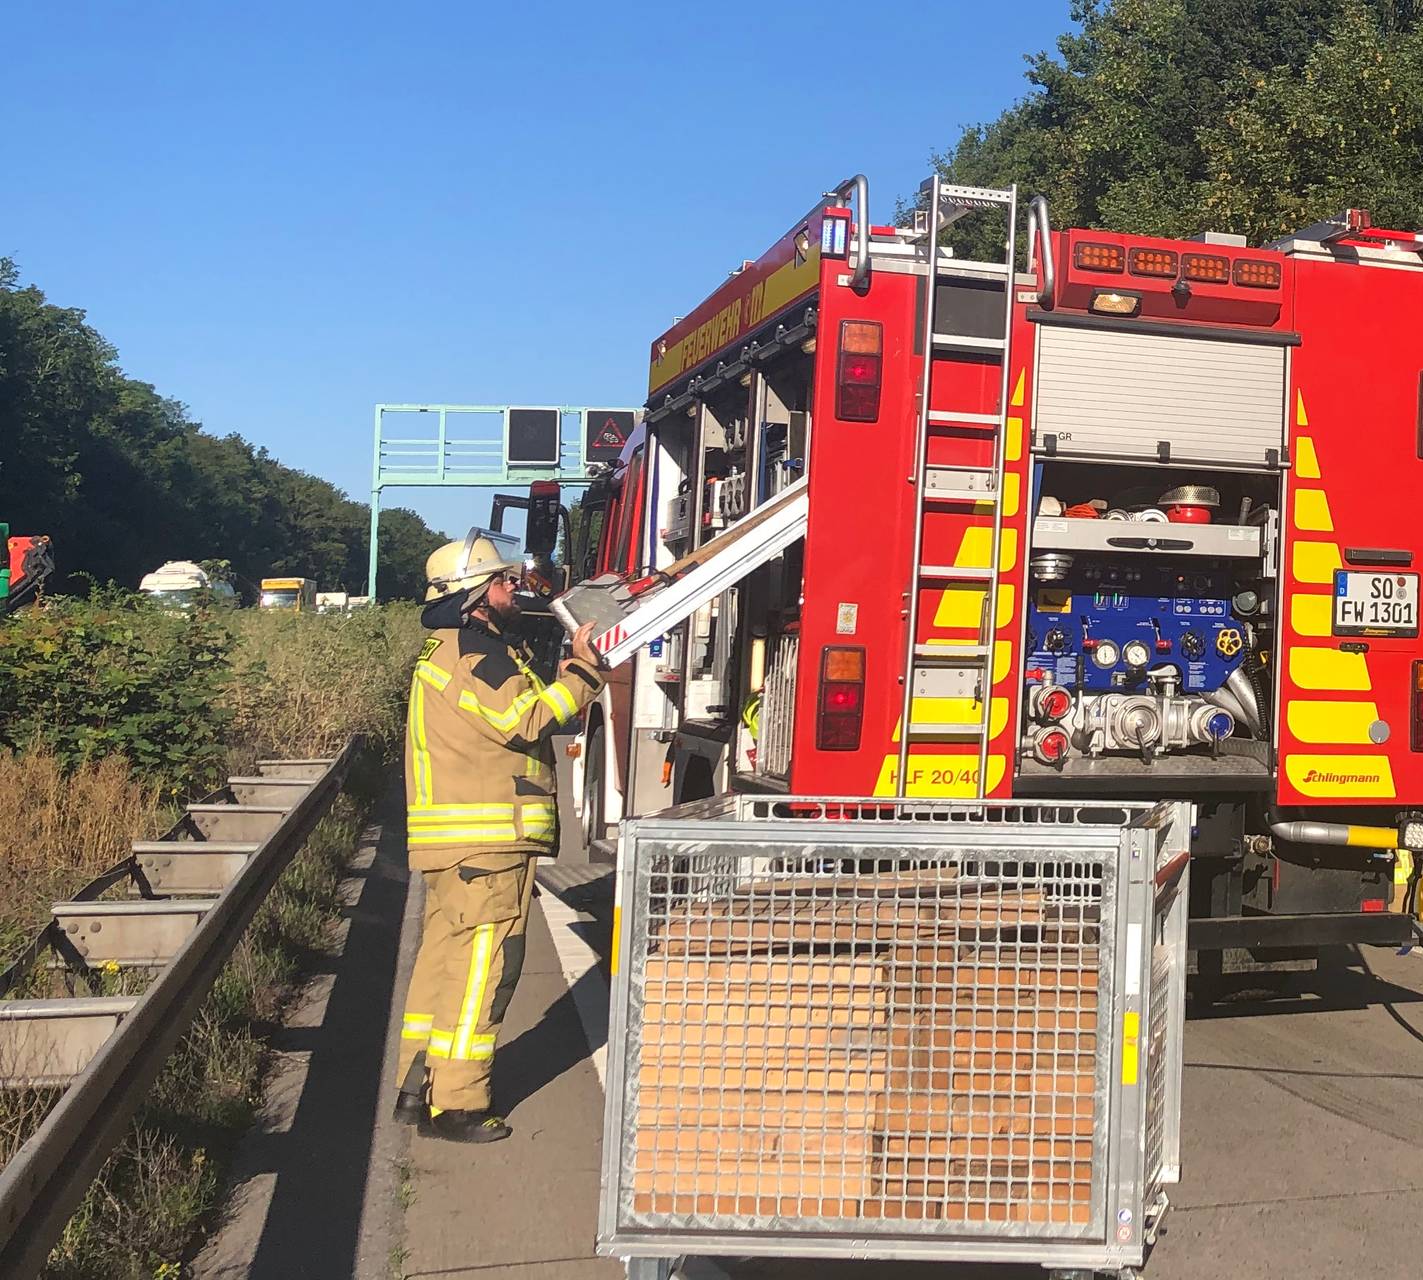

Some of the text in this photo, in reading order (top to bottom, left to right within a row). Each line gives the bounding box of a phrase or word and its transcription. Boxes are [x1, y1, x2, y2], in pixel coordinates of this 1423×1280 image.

[681, 298, 742, 371] FEUERWEHR
[1058, 431, 1072, 441] GR
[1370, 577, 1393, 599] SO
[1341, 600, 1413, 624] FW 1301
[1303, 769, 1380, 784] Schlingmann
